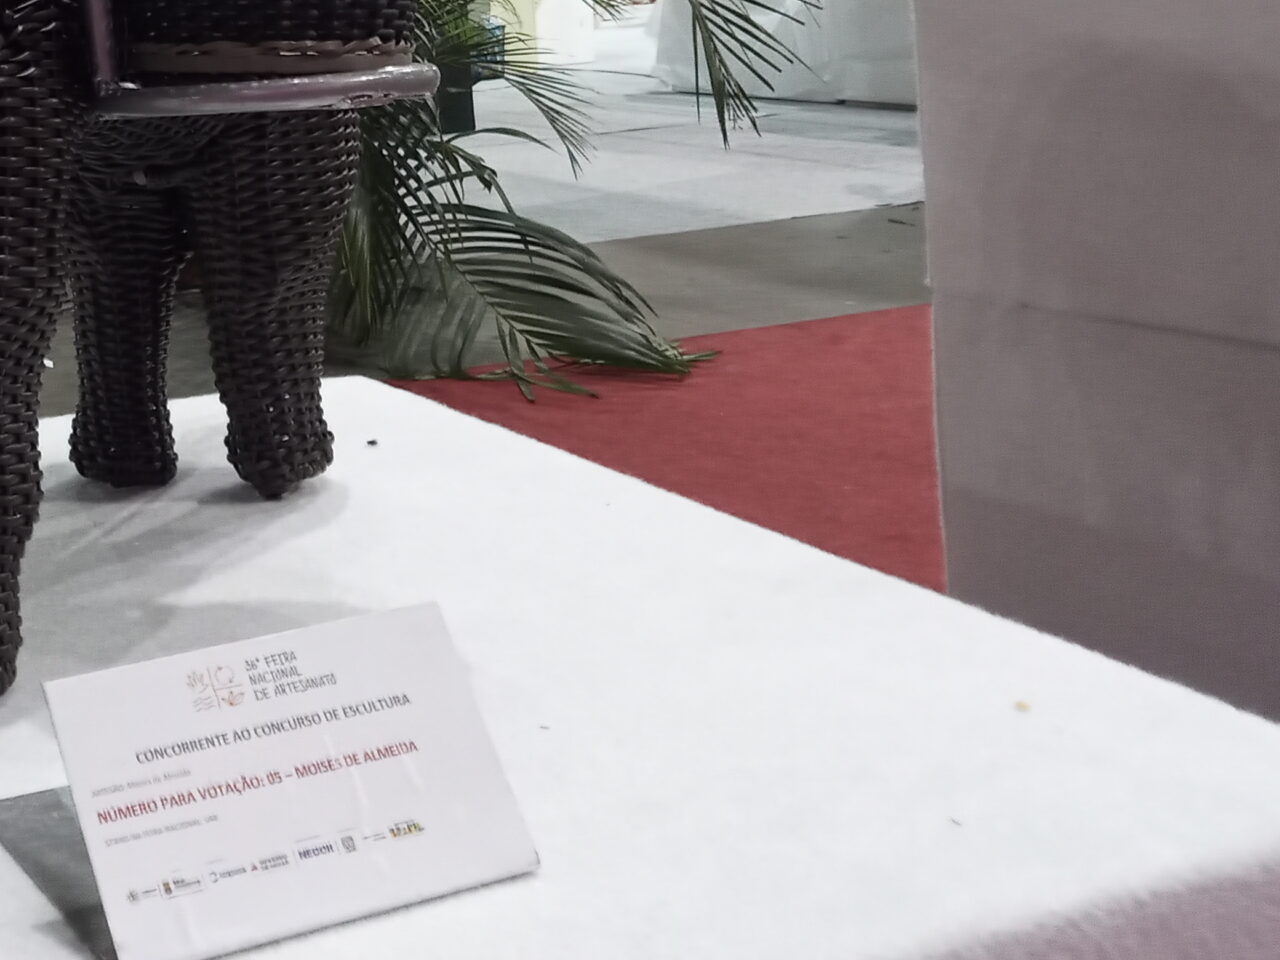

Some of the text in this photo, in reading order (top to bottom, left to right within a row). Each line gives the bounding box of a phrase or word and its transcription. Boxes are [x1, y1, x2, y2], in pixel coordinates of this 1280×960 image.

[264, 651, 297, 668] FEIRA
[248, 665, 302, 686] NACIONAL
[253, 672, 337, 701] DE ARTESANATO
[135, 693, 412, 764] CONCORRENTE AO CONCURSO DE ESCULTURA
[160, 791, 198, 811] PARA
[196, 774, 266, 800] VOTAÇÃO:
[266, 770, 284, 786] 05
[342, 753, 362, 767] DE
[363, 741, 420, 764] ALMEIDA
